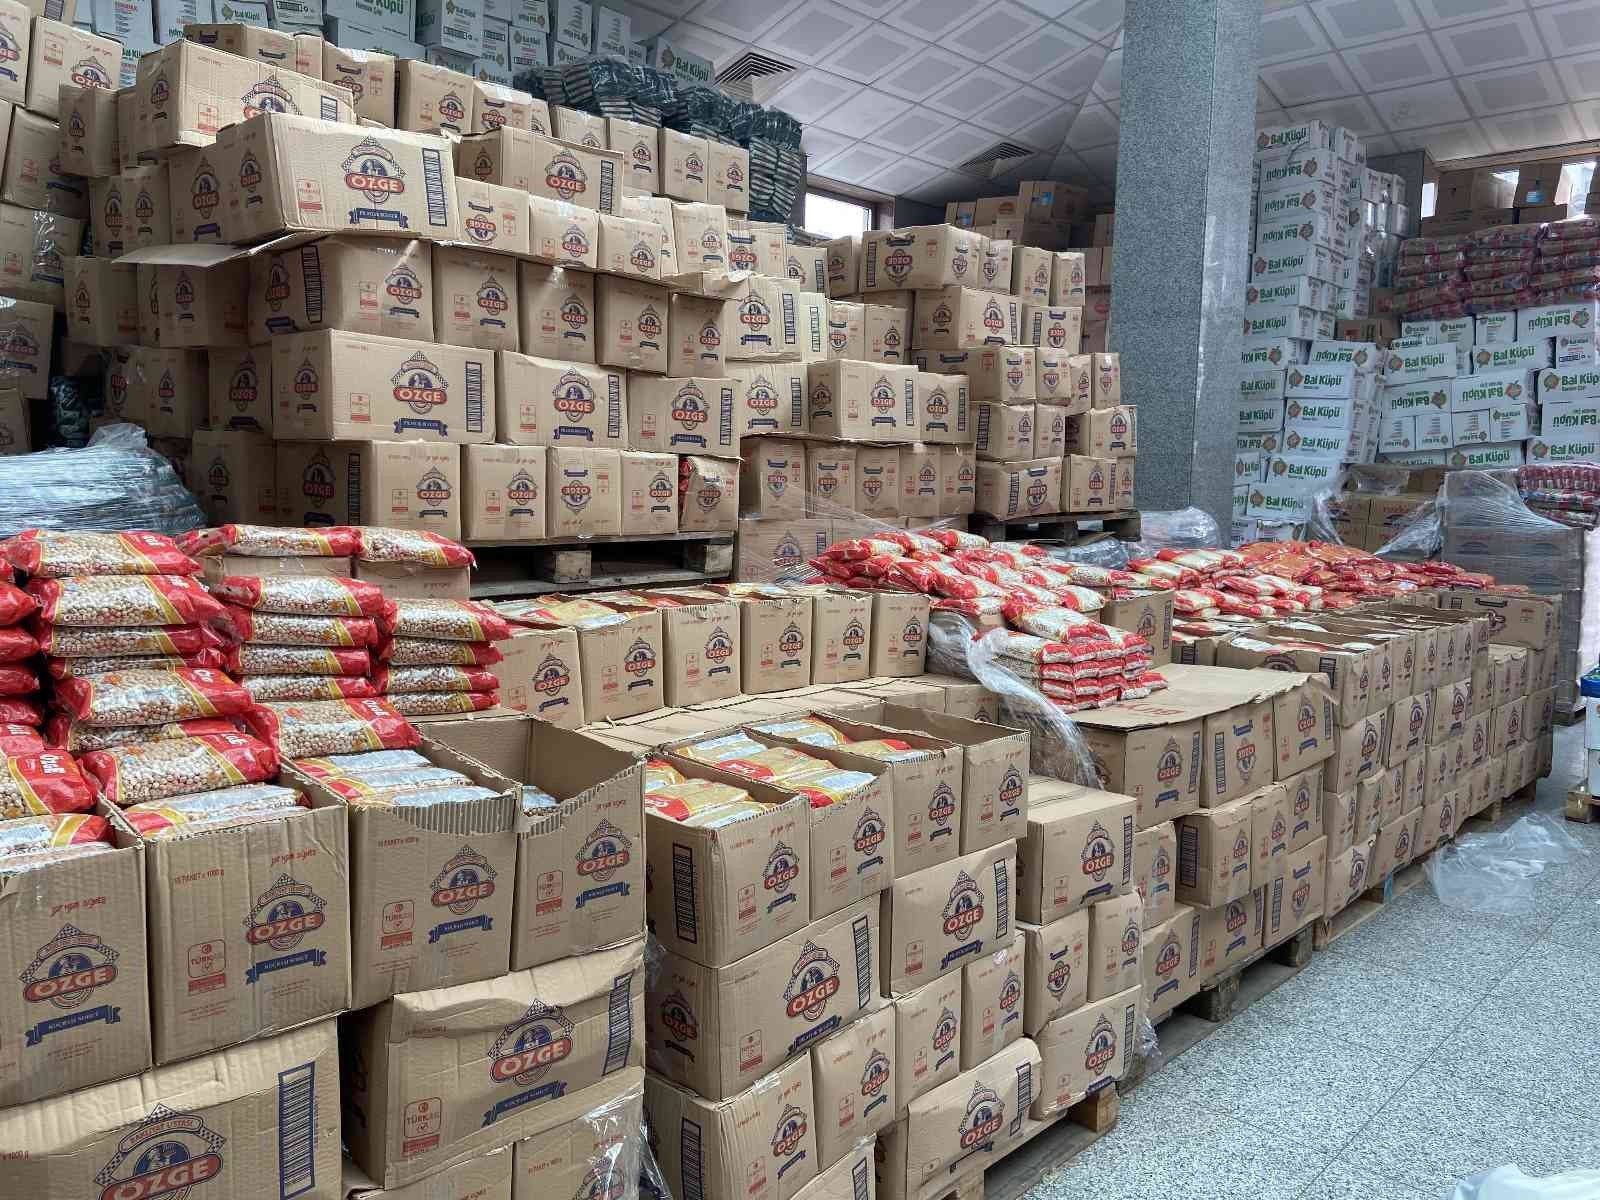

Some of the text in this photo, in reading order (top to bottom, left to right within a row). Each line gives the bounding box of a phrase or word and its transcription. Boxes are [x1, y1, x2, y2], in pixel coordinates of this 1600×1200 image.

[676, 57, 709, 81] Bal Küpü
[1281, 256, 1303, 270] Küpü
[1274, 283, 1295, 298] Küpü
[1265, 315, 1287, 329] Küpü
[1405, 354, 1444, 367] Bal Küpü
[1493, 347, 1534, 360] Bal Küpü
[1319, 374, 1341, 387] Küpü
[1562, 374, 1600, 387] Bal Küp
[1317, 406, 1340, 419] Küpü
[1302, 435, 1340, 449] Bal Küpü
[1469, 450, 1510, 464] Bal Küpü
[1550, 444, 1595, 456] Bal Küpü
[1289, 464, 1328, 478] Bal Küpü
